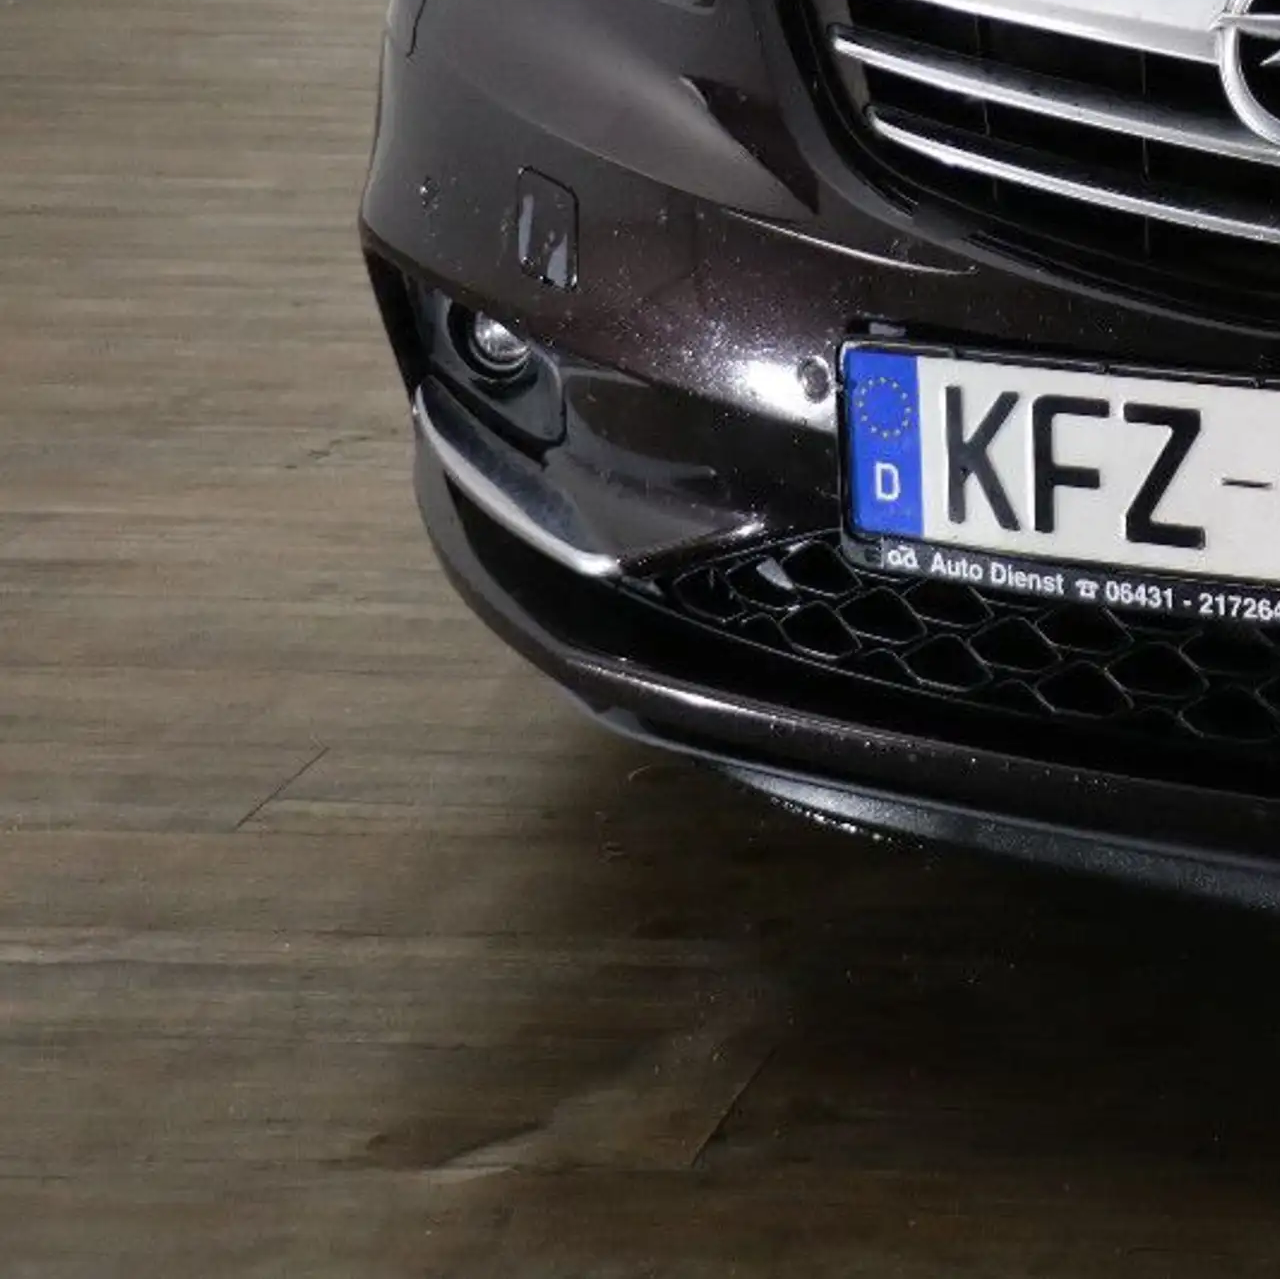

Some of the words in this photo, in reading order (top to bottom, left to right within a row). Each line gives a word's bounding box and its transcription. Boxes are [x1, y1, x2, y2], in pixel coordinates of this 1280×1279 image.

[874, 462, 902, 503] D
[930, 554, 983, 581] Auto
[990, 562, 1065, 596] Dienst
[1105, 581, 1175, 610] 06431
